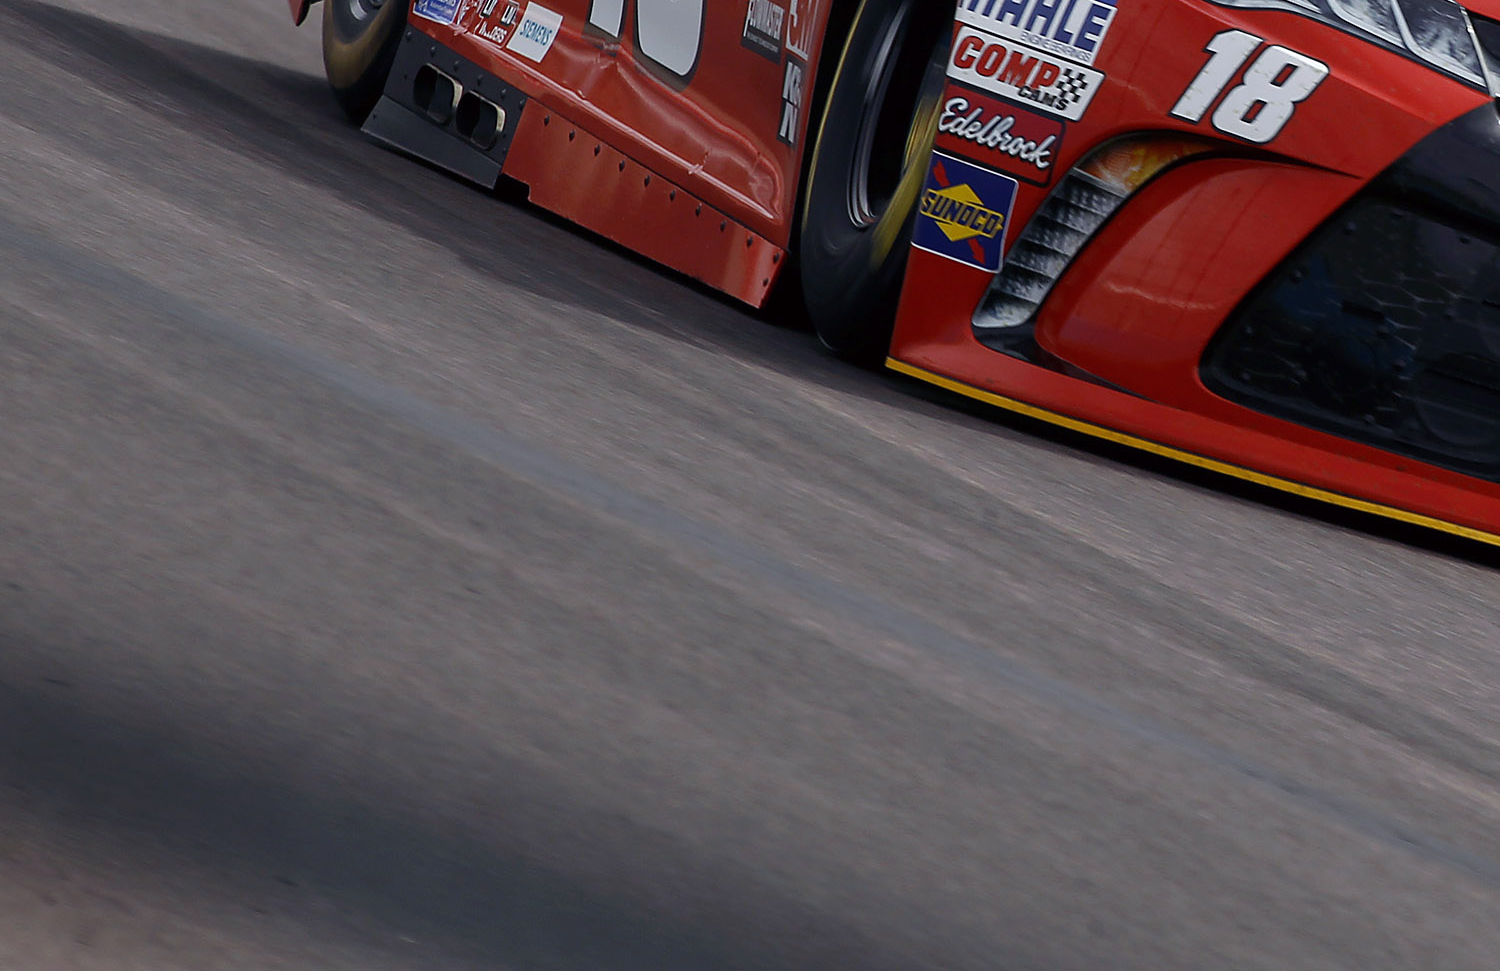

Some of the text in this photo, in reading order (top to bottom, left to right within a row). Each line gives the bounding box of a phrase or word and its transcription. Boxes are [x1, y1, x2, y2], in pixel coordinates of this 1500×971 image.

[519, 19, 553, 46] SIEMENS
[953, 35, 1061, 91] COMP
[1169, 29, 1331, 144] 18
[1018, 85, 1069, 111] CAMS
[938, 97, 1055, 170] Edelbrock
[922, 191, 1001, 235] SUNOCO
